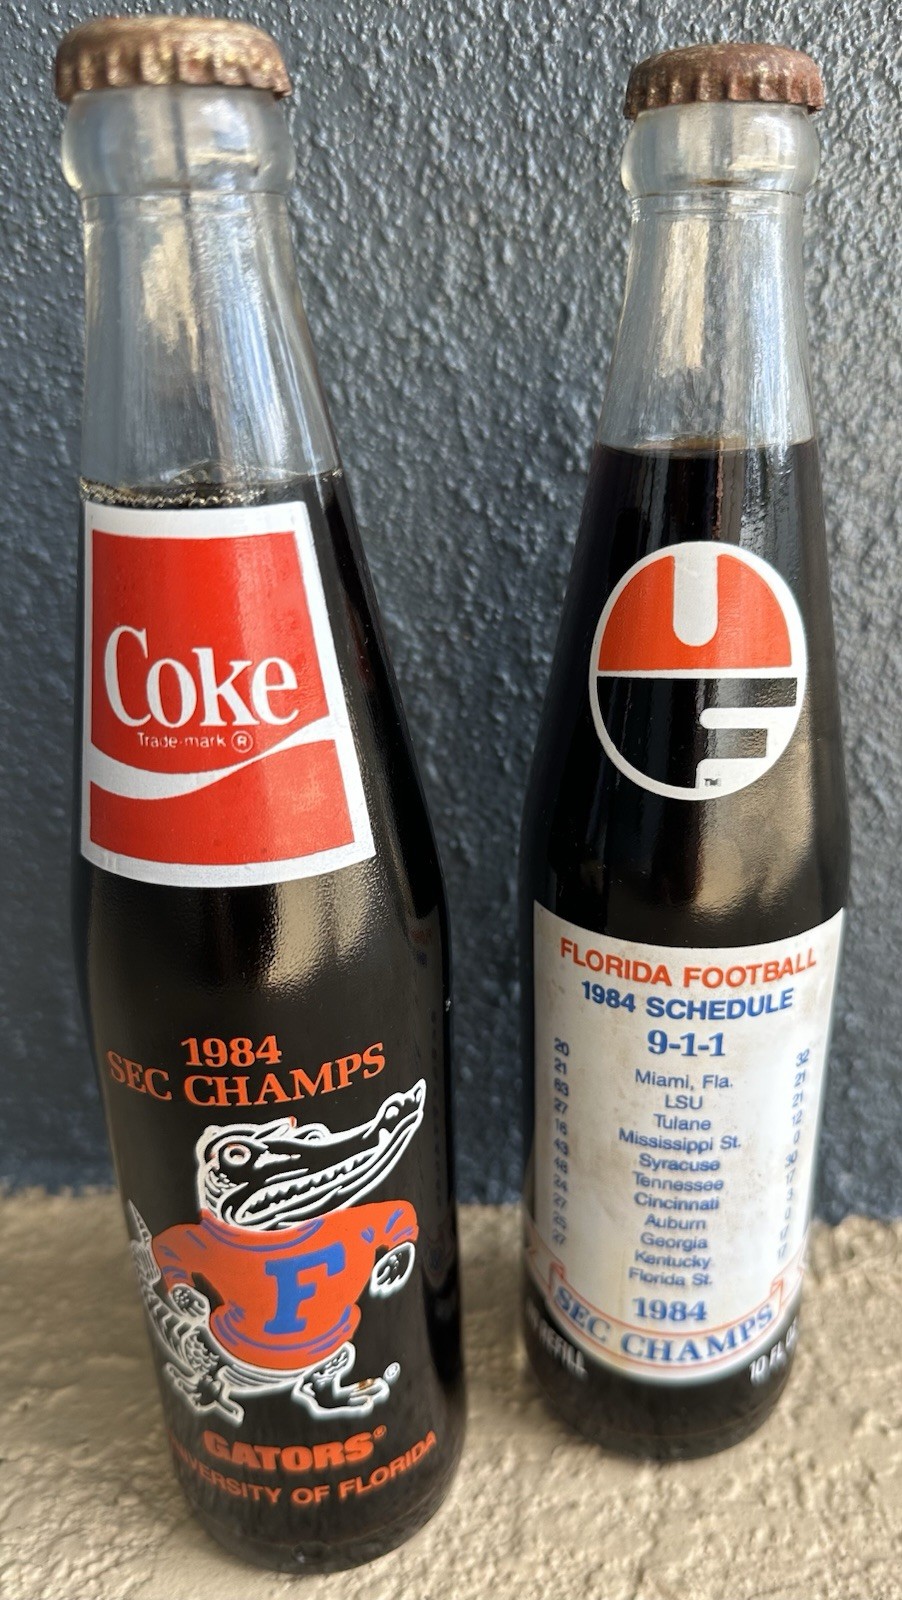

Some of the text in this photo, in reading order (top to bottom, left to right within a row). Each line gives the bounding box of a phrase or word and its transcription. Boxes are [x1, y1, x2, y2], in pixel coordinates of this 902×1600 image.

[104, 625, 299, 729] Coke
[560, 937, 817, 988] FLORIDA FOOTBALL
[581, 981, 794, 1020] 1984 SCHEDULE
[181, 1035, 282, 1067] 1984
[648, 1029, 726, 1056] 9-1-1
[106, 1042, 386, 1107] SEC CHAMPS
[554, 1037, 569, 1056] 20
[635, 1068, 694, 1091] Miami,
[702, 1074, 733, 1088] Fla.
[554, 1057, 567, 1075] 21
[665, 1094, 703, 1110] LSU
[653, 1113, 711, 1131] Tulane
[619, 1128, 713, 1152] Mississippi
[720, 1134, 741, 1149] St.
[639, 1153, 720, 1175] Syracuse
[632, 1171, 724, 1192] Tennessee
[633, 1192, 719, 1211] Cincinnati
[645, 1213, 706, 1230] Auburn
[640, 1232, 708, 1251] Georgia
[634, 1250, 711, 1269] Kentucky
[265, 1241, 346, 1334] F
[629, 1267, 685, 1286] Florida
[692, 1272, 712, 1286] St.
[632, 1297, 707, 1322] 1984
[556, 1286, 610, 1342] SEC
[620, 1304, 773, 1362] CHAMPS
[291, 1484, 330, 1504] OF
[338, 1430, 436, 1499] FLORIDA
